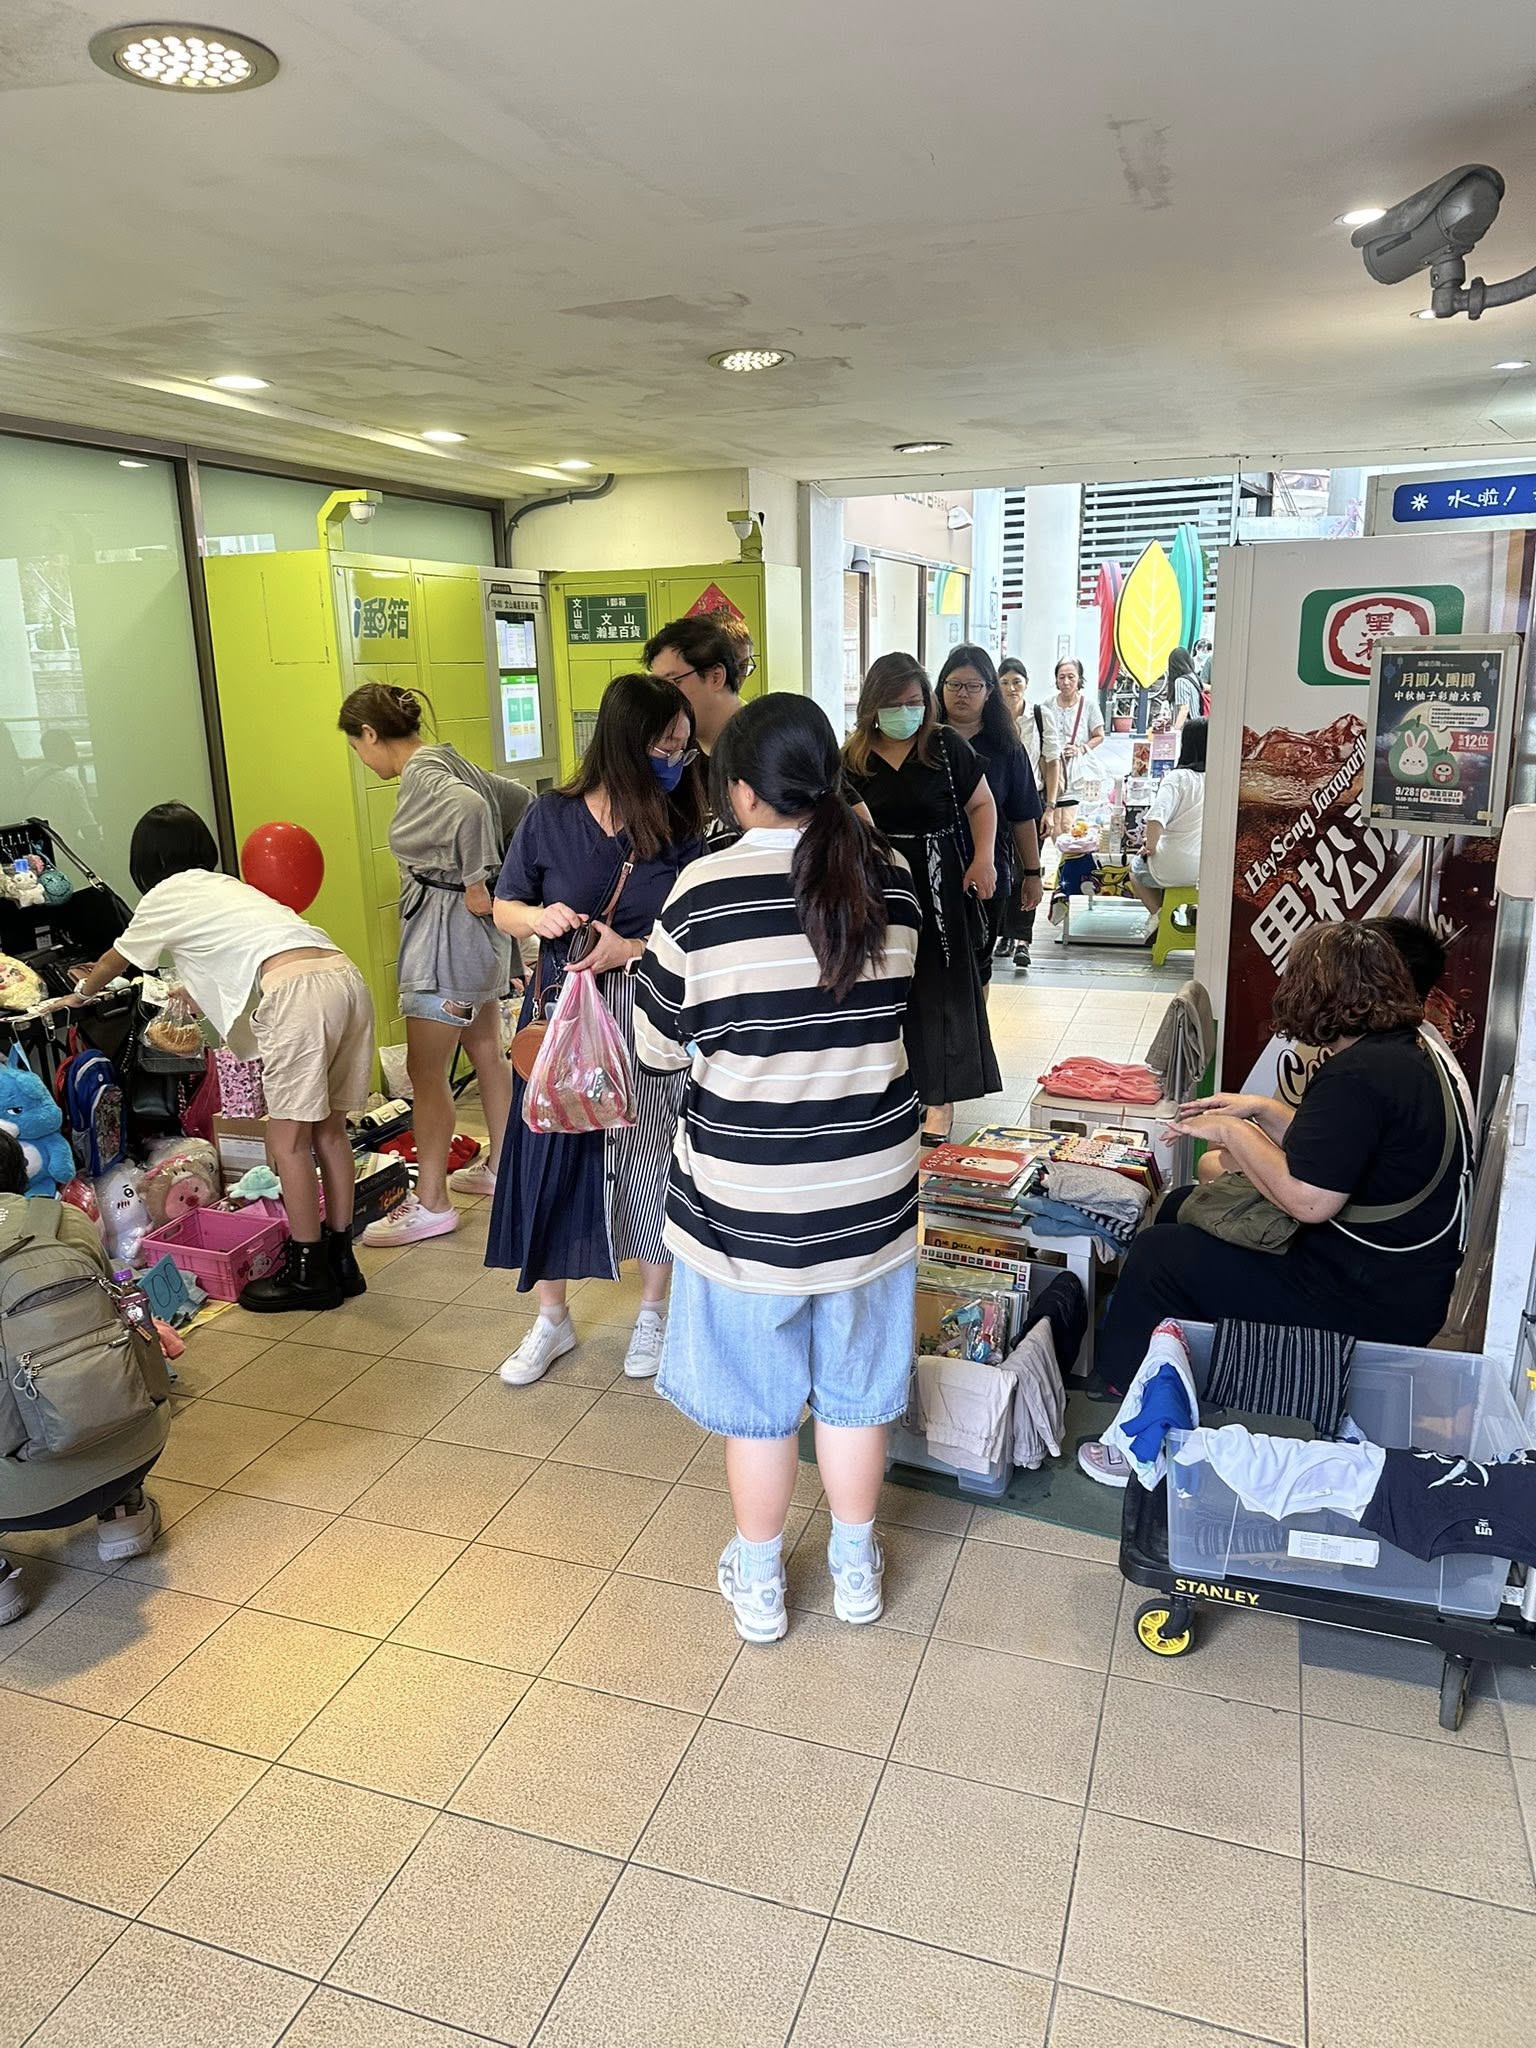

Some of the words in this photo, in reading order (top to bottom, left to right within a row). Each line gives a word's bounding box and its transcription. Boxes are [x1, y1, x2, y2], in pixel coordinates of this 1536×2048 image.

[353, 597, 410, 640] i郵箱
[572, 597, 583, 629] 文山區
[595, 625, 641, 639] 瀚星百貨
[1394, 690, 1482, 702] 中秋柚子彩繪大賽
[1311, 734, 1367, 819] Sarsaparill
[1395, 786, 1415, 797] 9/28
[1175, 1579, 1260, 1606] STANLEY
